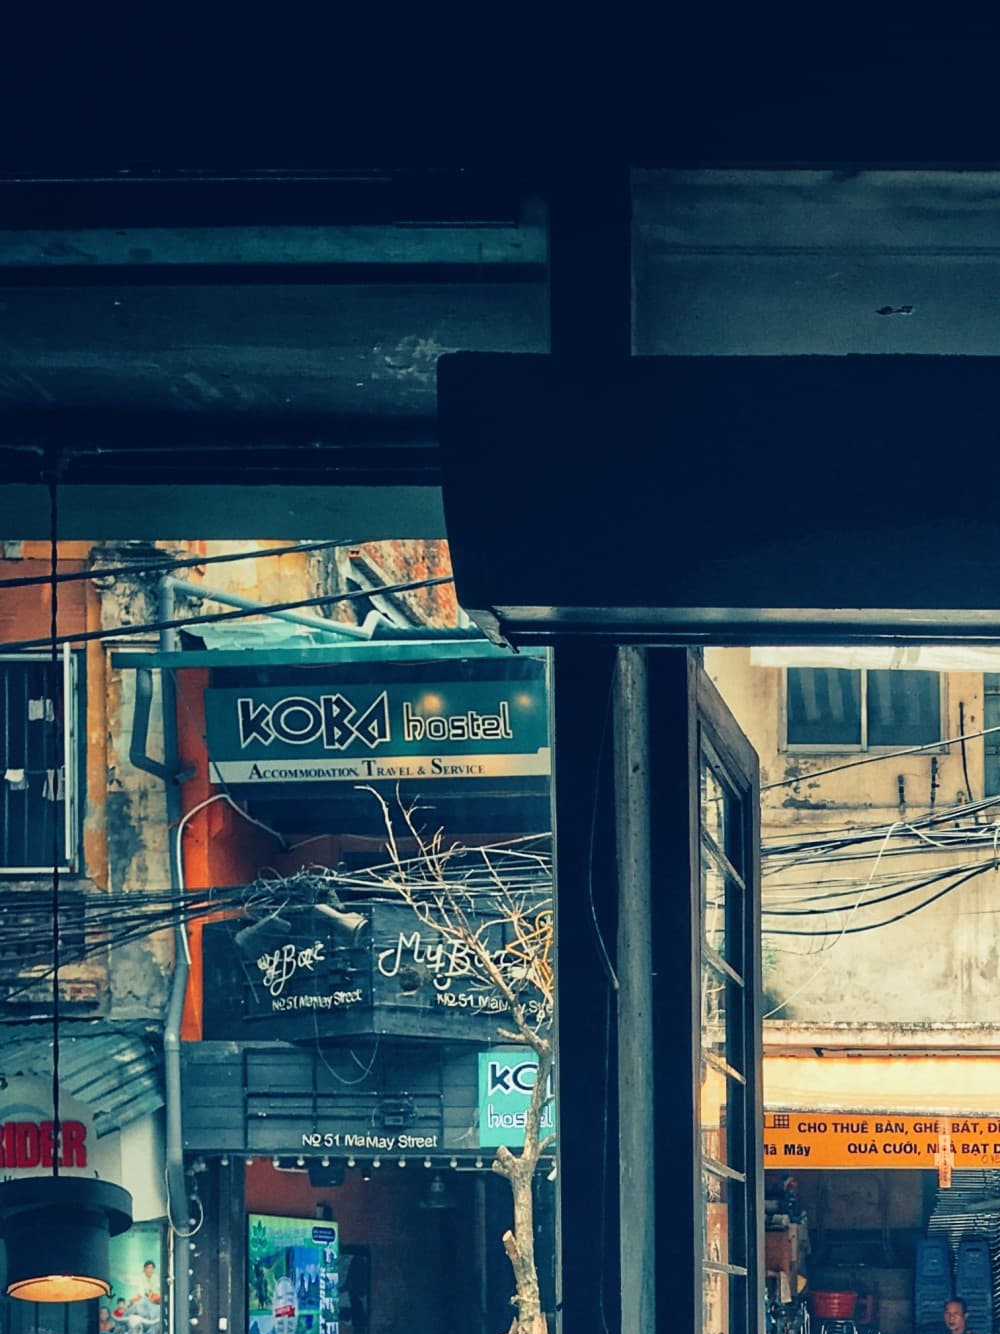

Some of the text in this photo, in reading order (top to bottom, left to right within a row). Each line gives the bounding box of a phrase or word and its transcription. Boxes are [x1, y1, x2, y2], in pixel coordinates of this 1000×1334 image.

[237, 691, 512, 750] KOBA hostel
[362, 759, 413, 777] TRAVEL
[417, 765, 425, 776] &
[431, 757, 485, 775] SERVICE
[798, 1122, 828, 1134] CHO
[832, 1120, 869, 1134] THUÊ
[875, 1119, 909, 1136] BÀN,
[952, 1119, 983, 1136] BÁT,
[0, 1120, 88, 1168] IDER
[323, 1134, 340, 1146] 51
[398, 1134, 438, 1149] Street
[927, 1139, 957, 1154] NÀ
[961, 1143, 989, 1156] BẠT
